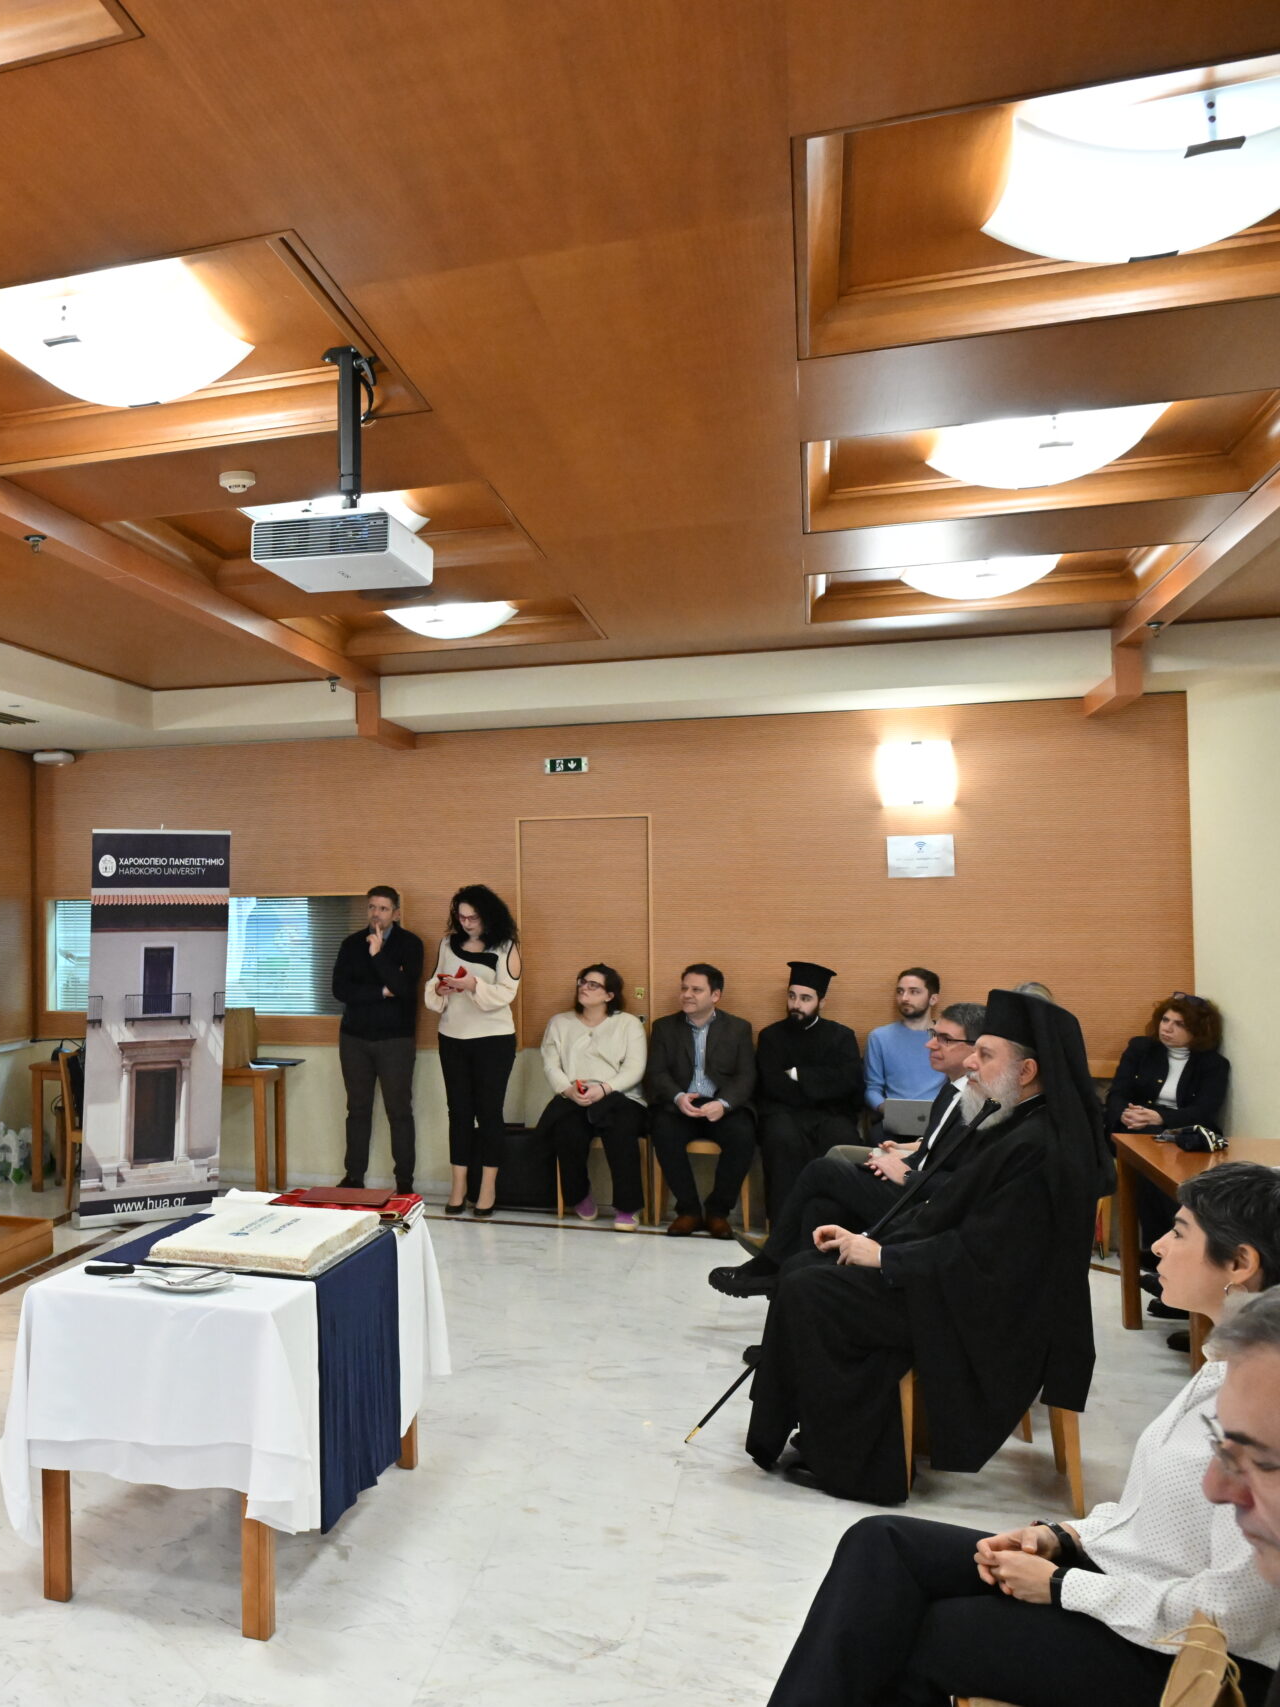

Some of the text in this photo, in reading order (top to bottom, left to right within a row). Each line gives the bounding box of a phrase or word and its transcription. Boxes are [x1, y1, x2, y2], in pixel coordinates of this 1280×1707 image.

[119, 857, 225, 866] ΧΑΡΟΚΟΠΕΙΟ ΠΑΝΕΠΙΣΤΗΜΙΟ
[118, 867, 206, 875] HAROKOPIO UNIVERSITY
[113, 1197, 186, 1214] www.hua.gr
